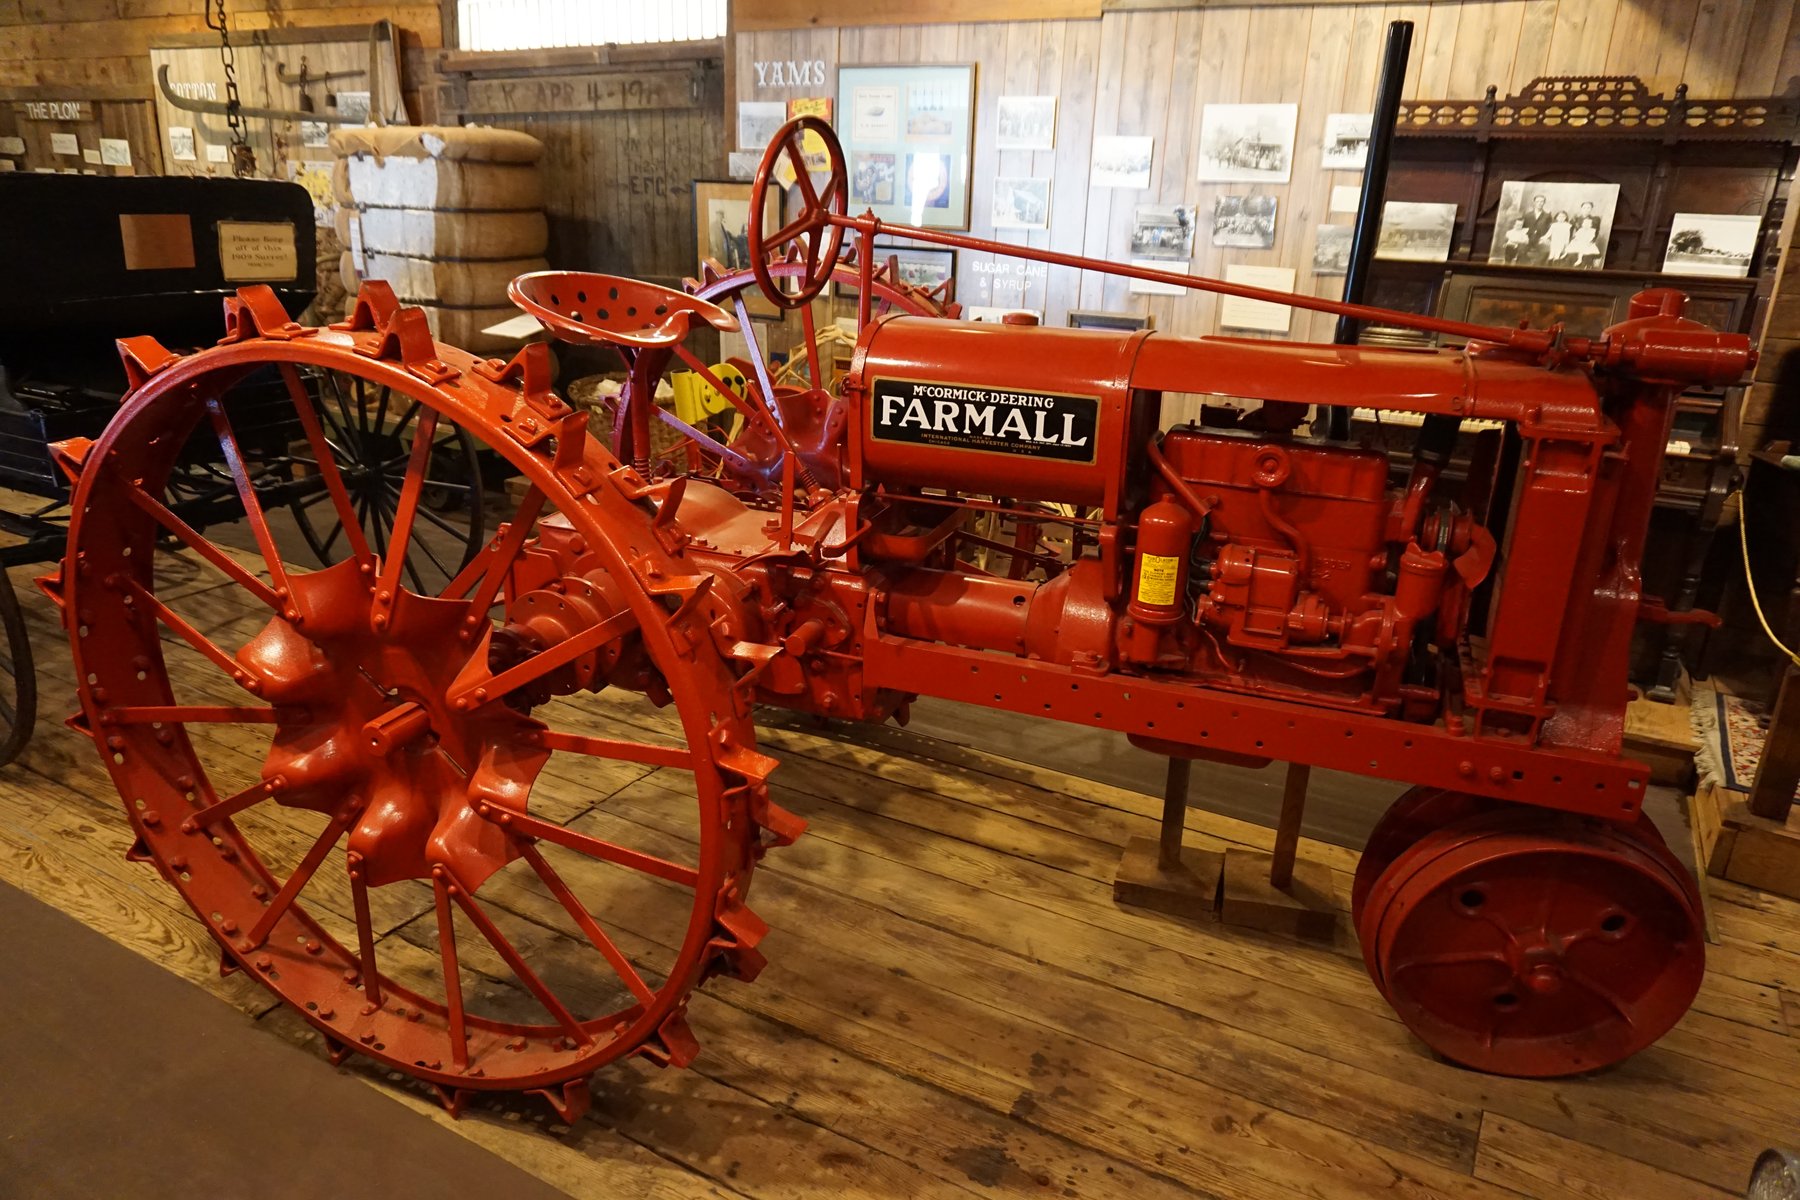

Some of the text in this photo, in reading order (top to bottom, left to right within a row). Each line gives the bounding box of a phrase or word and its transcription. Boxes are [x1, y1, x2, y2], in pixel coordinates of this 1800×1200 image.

[754, 60, 826, 88] YAMS
[25, 101, 80, 120] THE PLOW
[972, 260, 1048, 278] SUGAR CANE
[979, 276, 1032, 291] & SYRUP
[880, 395, 1088, 447] FARMALL
[920, 433, 970, 444] INTERNATIONAL
[971, 438, 1009, 448] HARVESTER
[1011, 442, 1041, 451] COMPANY
